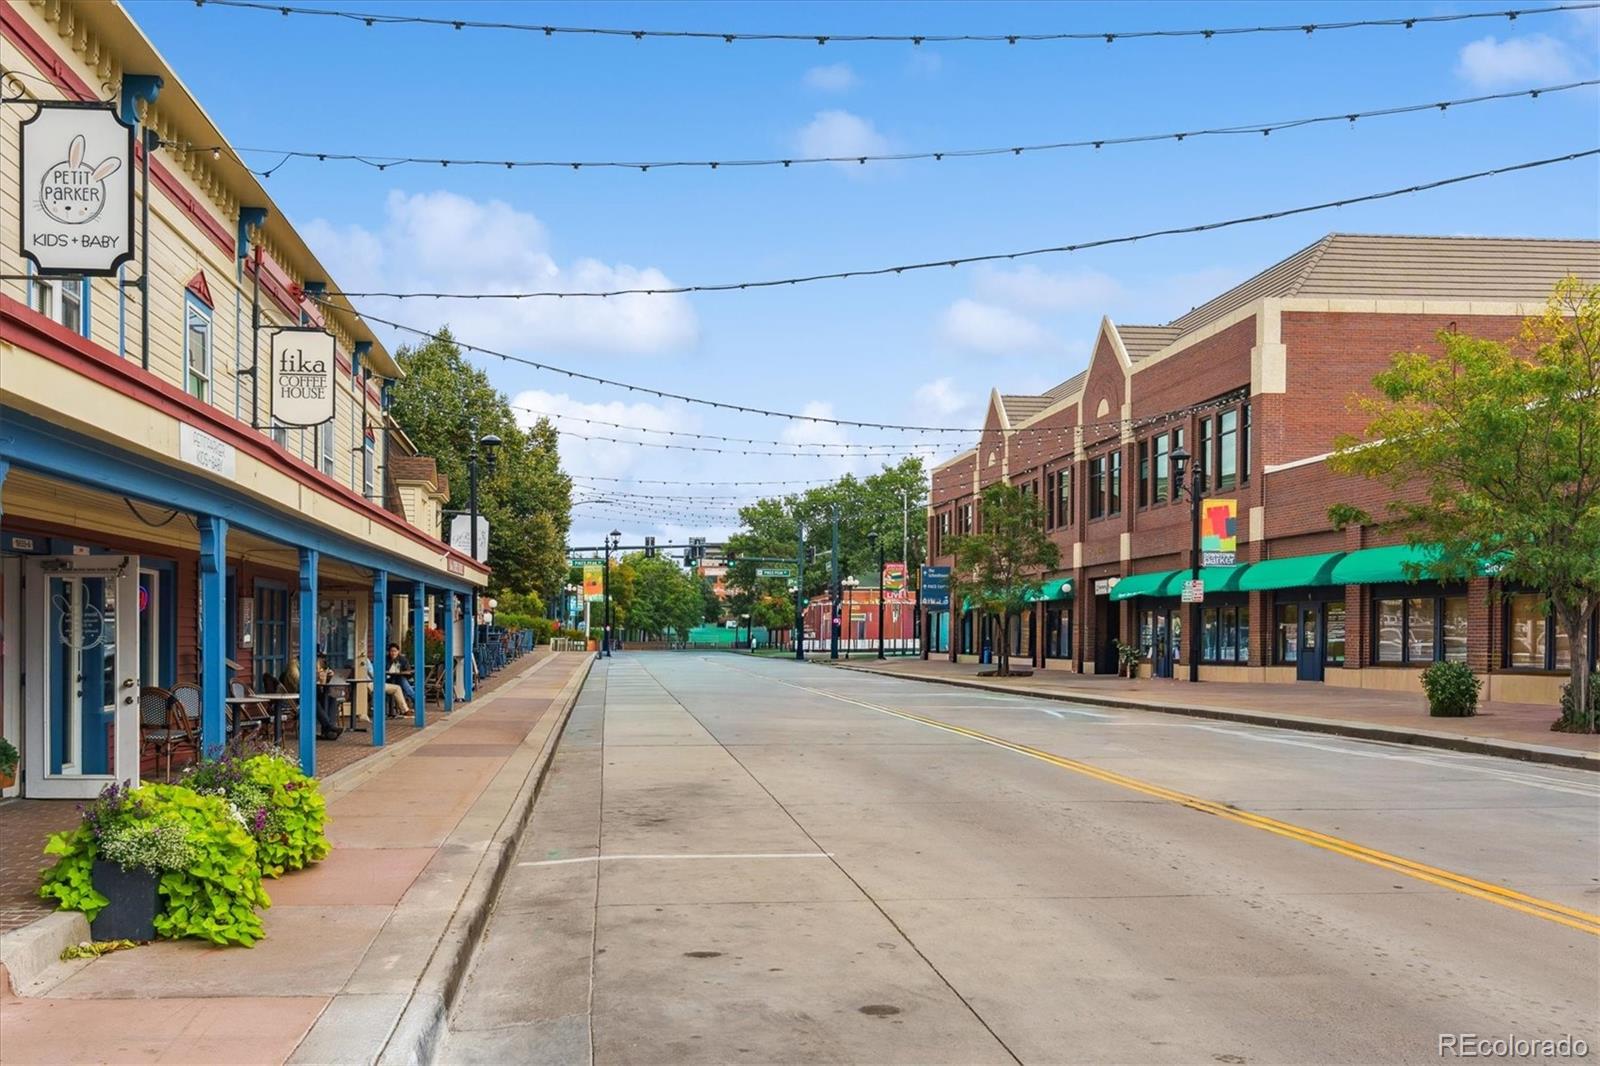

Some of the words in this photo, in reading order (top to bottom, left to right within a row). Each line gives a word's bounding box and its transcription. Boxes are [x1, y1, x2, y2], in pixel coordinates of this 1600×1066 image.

[33, 233, 69, 247] KIDS
[71, 236, 79, 244] +
[81, 234, 120, 248] BABY
[279, 348, 327, 373] fika
[278, 375, 328, 388] COFFEE
[281, 387, 326, 399] HOUSE
